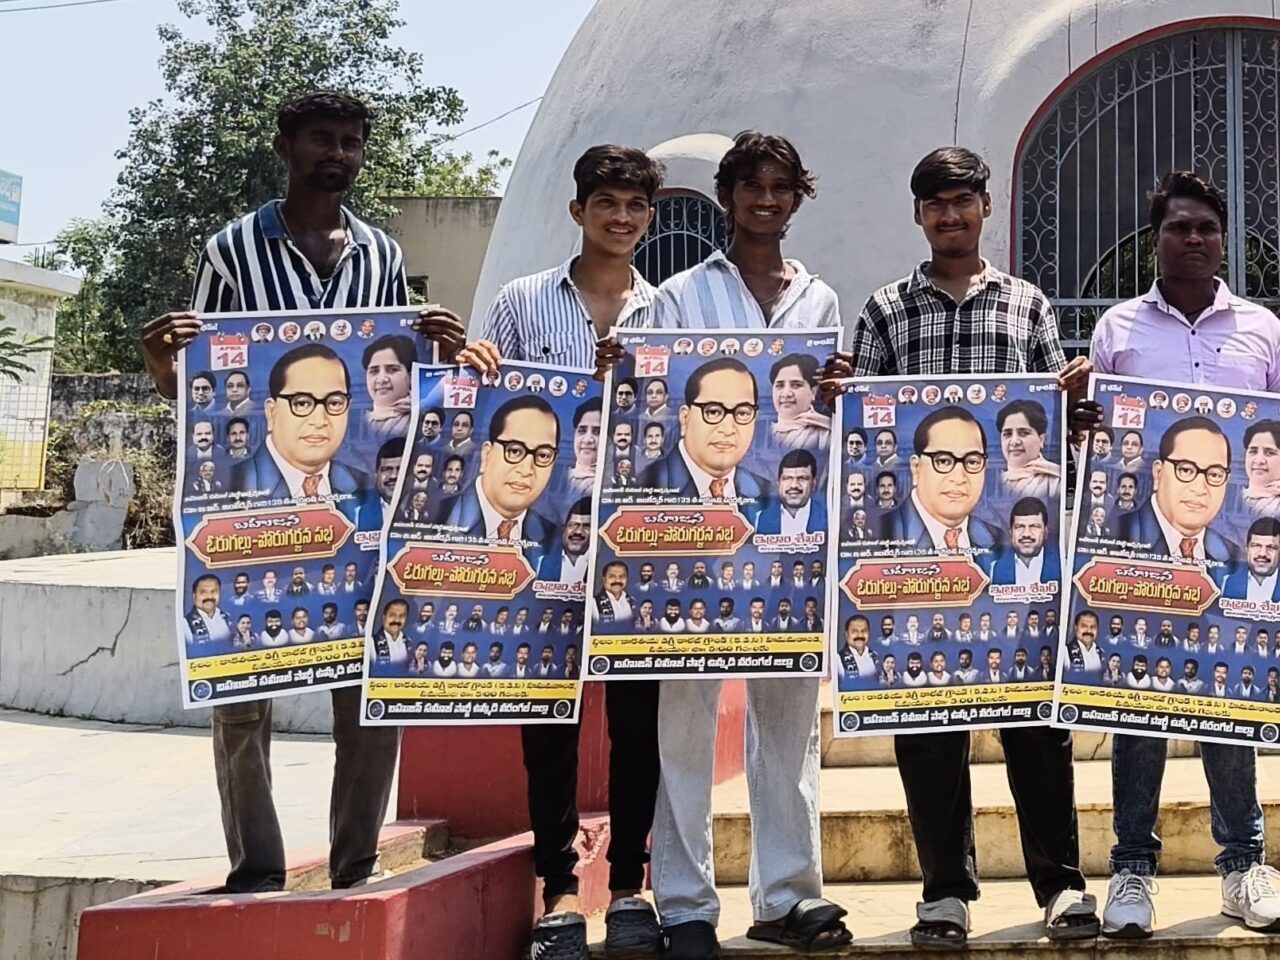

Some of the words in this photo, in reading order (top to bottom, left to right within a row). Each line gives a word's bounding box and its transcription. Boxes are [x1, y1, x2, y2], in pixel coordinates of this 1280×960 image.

[217, 351, 244, 366] 14
[640, 361, 666, 374] 14
[448, 391, 474, 406] 14
[868, 412, 892, 424] 14
[1117, 412, 1142, 426] 14
